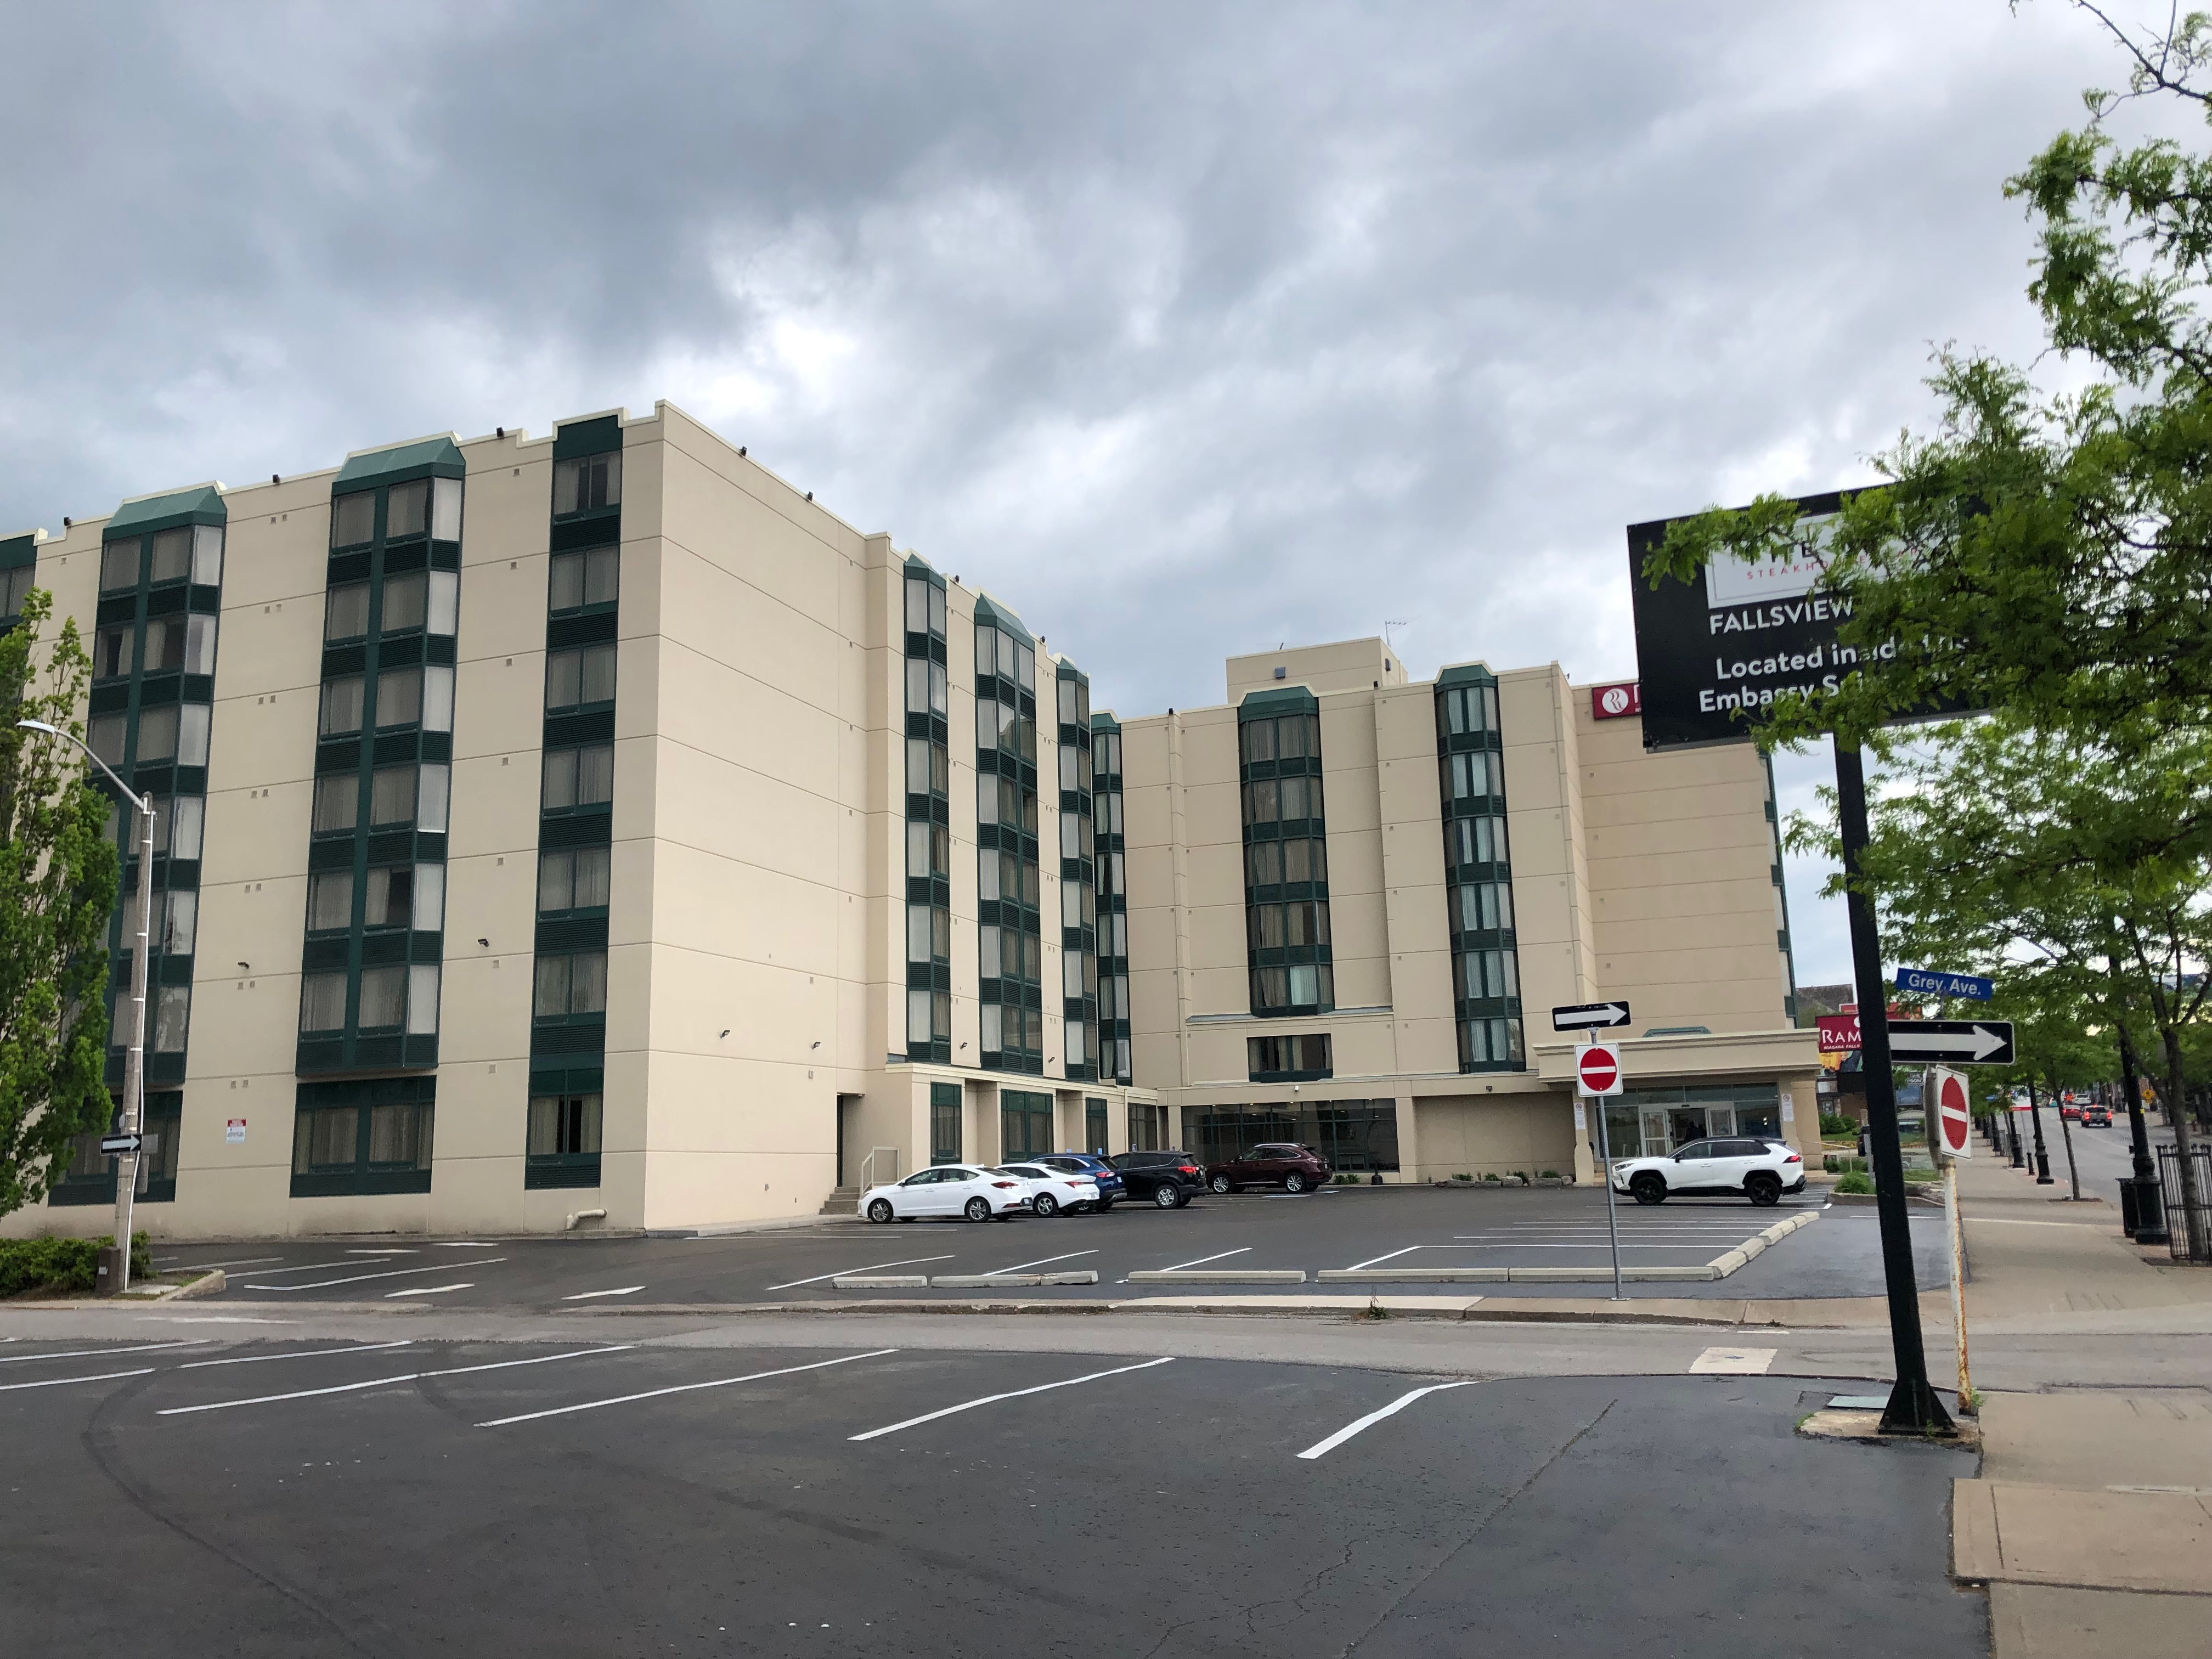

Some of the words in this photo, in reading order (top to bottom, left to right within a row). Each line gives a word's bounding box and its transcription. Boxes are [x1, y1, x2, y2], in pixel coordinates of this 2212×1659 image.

[1747, 555, 1866, 580] STEAKHOE
[1709, 596, 1853, 635] FALLSVIEW
[1716, 644, 1824, 680] Located
[1909, 973, 1944, 992] Grey
[1949, 978, 1981, 996] Ave.
